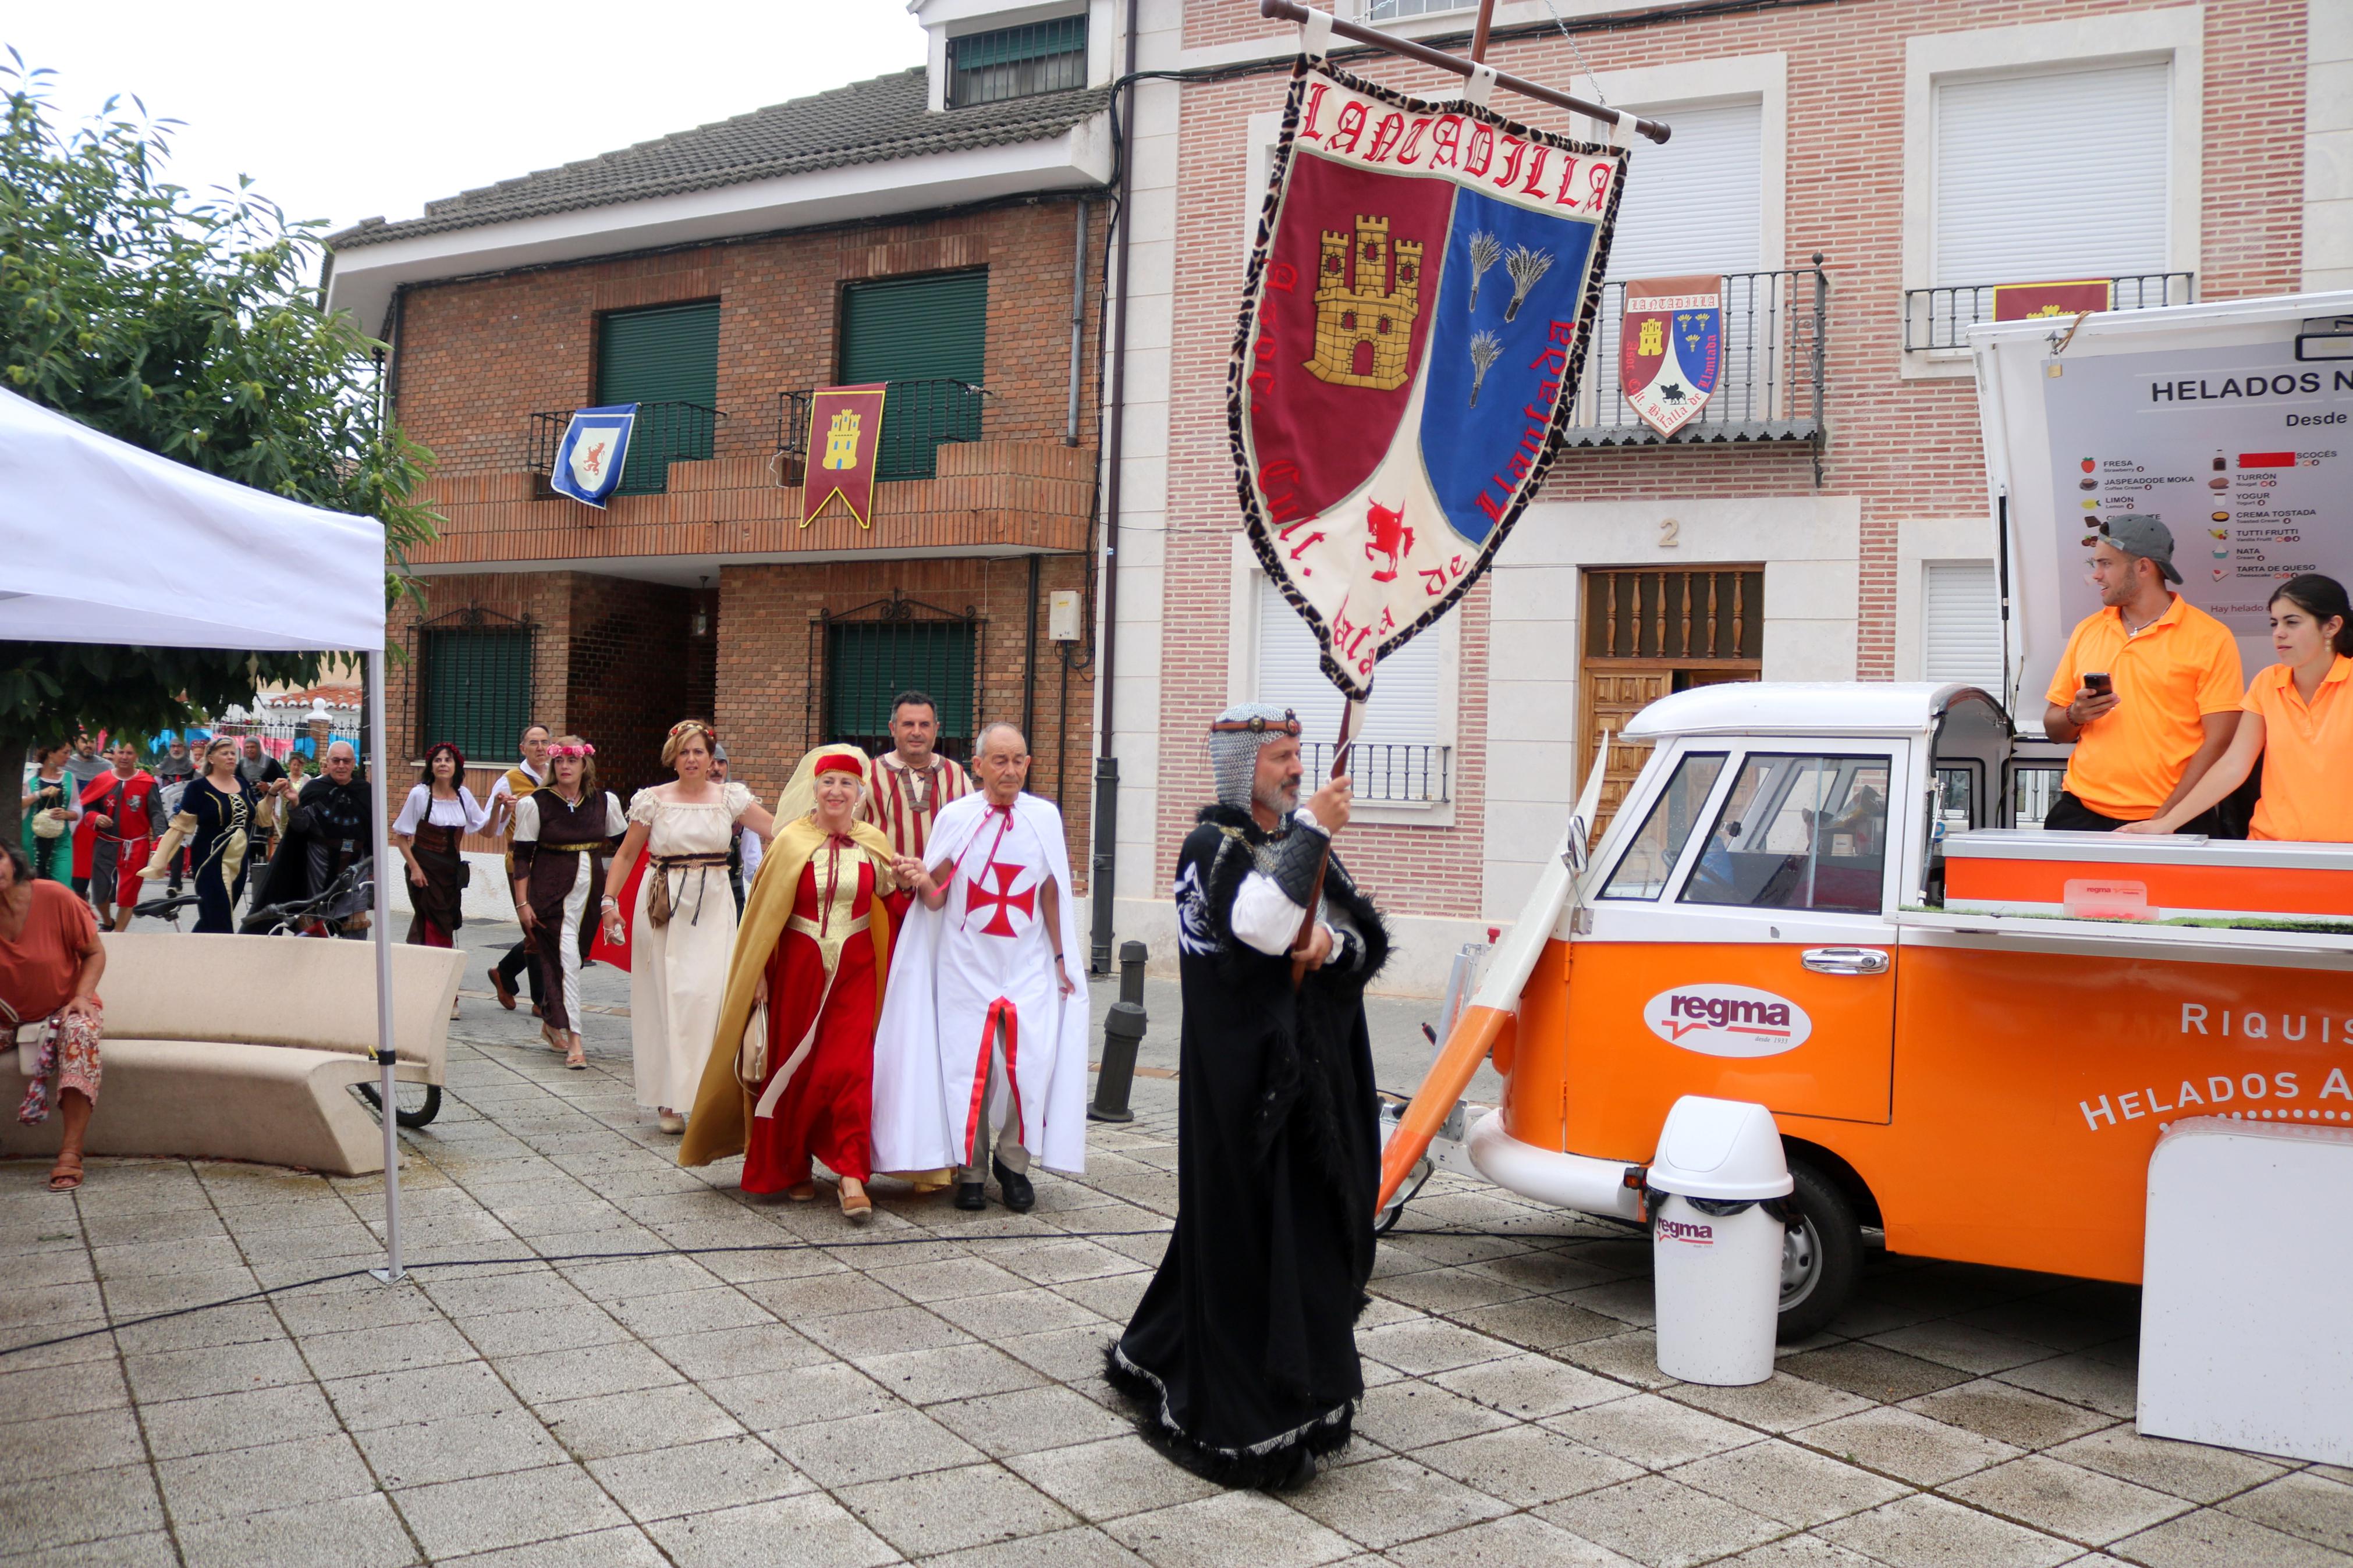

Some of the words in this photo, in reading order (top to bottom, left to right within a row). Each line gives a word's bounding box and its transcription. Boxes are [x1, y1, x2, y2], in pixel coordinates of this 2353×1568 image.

[1299, 82, 1616, 214] LANTADILLA
[1631, 296, 1716, 311] LANTADILLA
[1646, 403, 1688, 428] Batalla
[1687, 393, 1702, 406] de
[1697, 335, 1717, 389] Llantada
[2152, 372, 2320, 402] HELADOS
[2286, 412, 2347, 426] Desde
[1258, 459, 1326, 577] Cult.
[1418, 554, 1468, 596] de
[1474, 319, 1576, 525] Llantada
[2297, 450, 2337, 459] SCOCÉS
[2104, 477, 2165, 485] JASPEADODE
[1659, 518, 1678, 547] 2
[2211, 605, 2229, 614] Hay
[1670, 995, 1791, 1027] regma
[2079, 1072, 2300, 1131] HELADOS
[1658, 1217, 1713, 1239] regma
